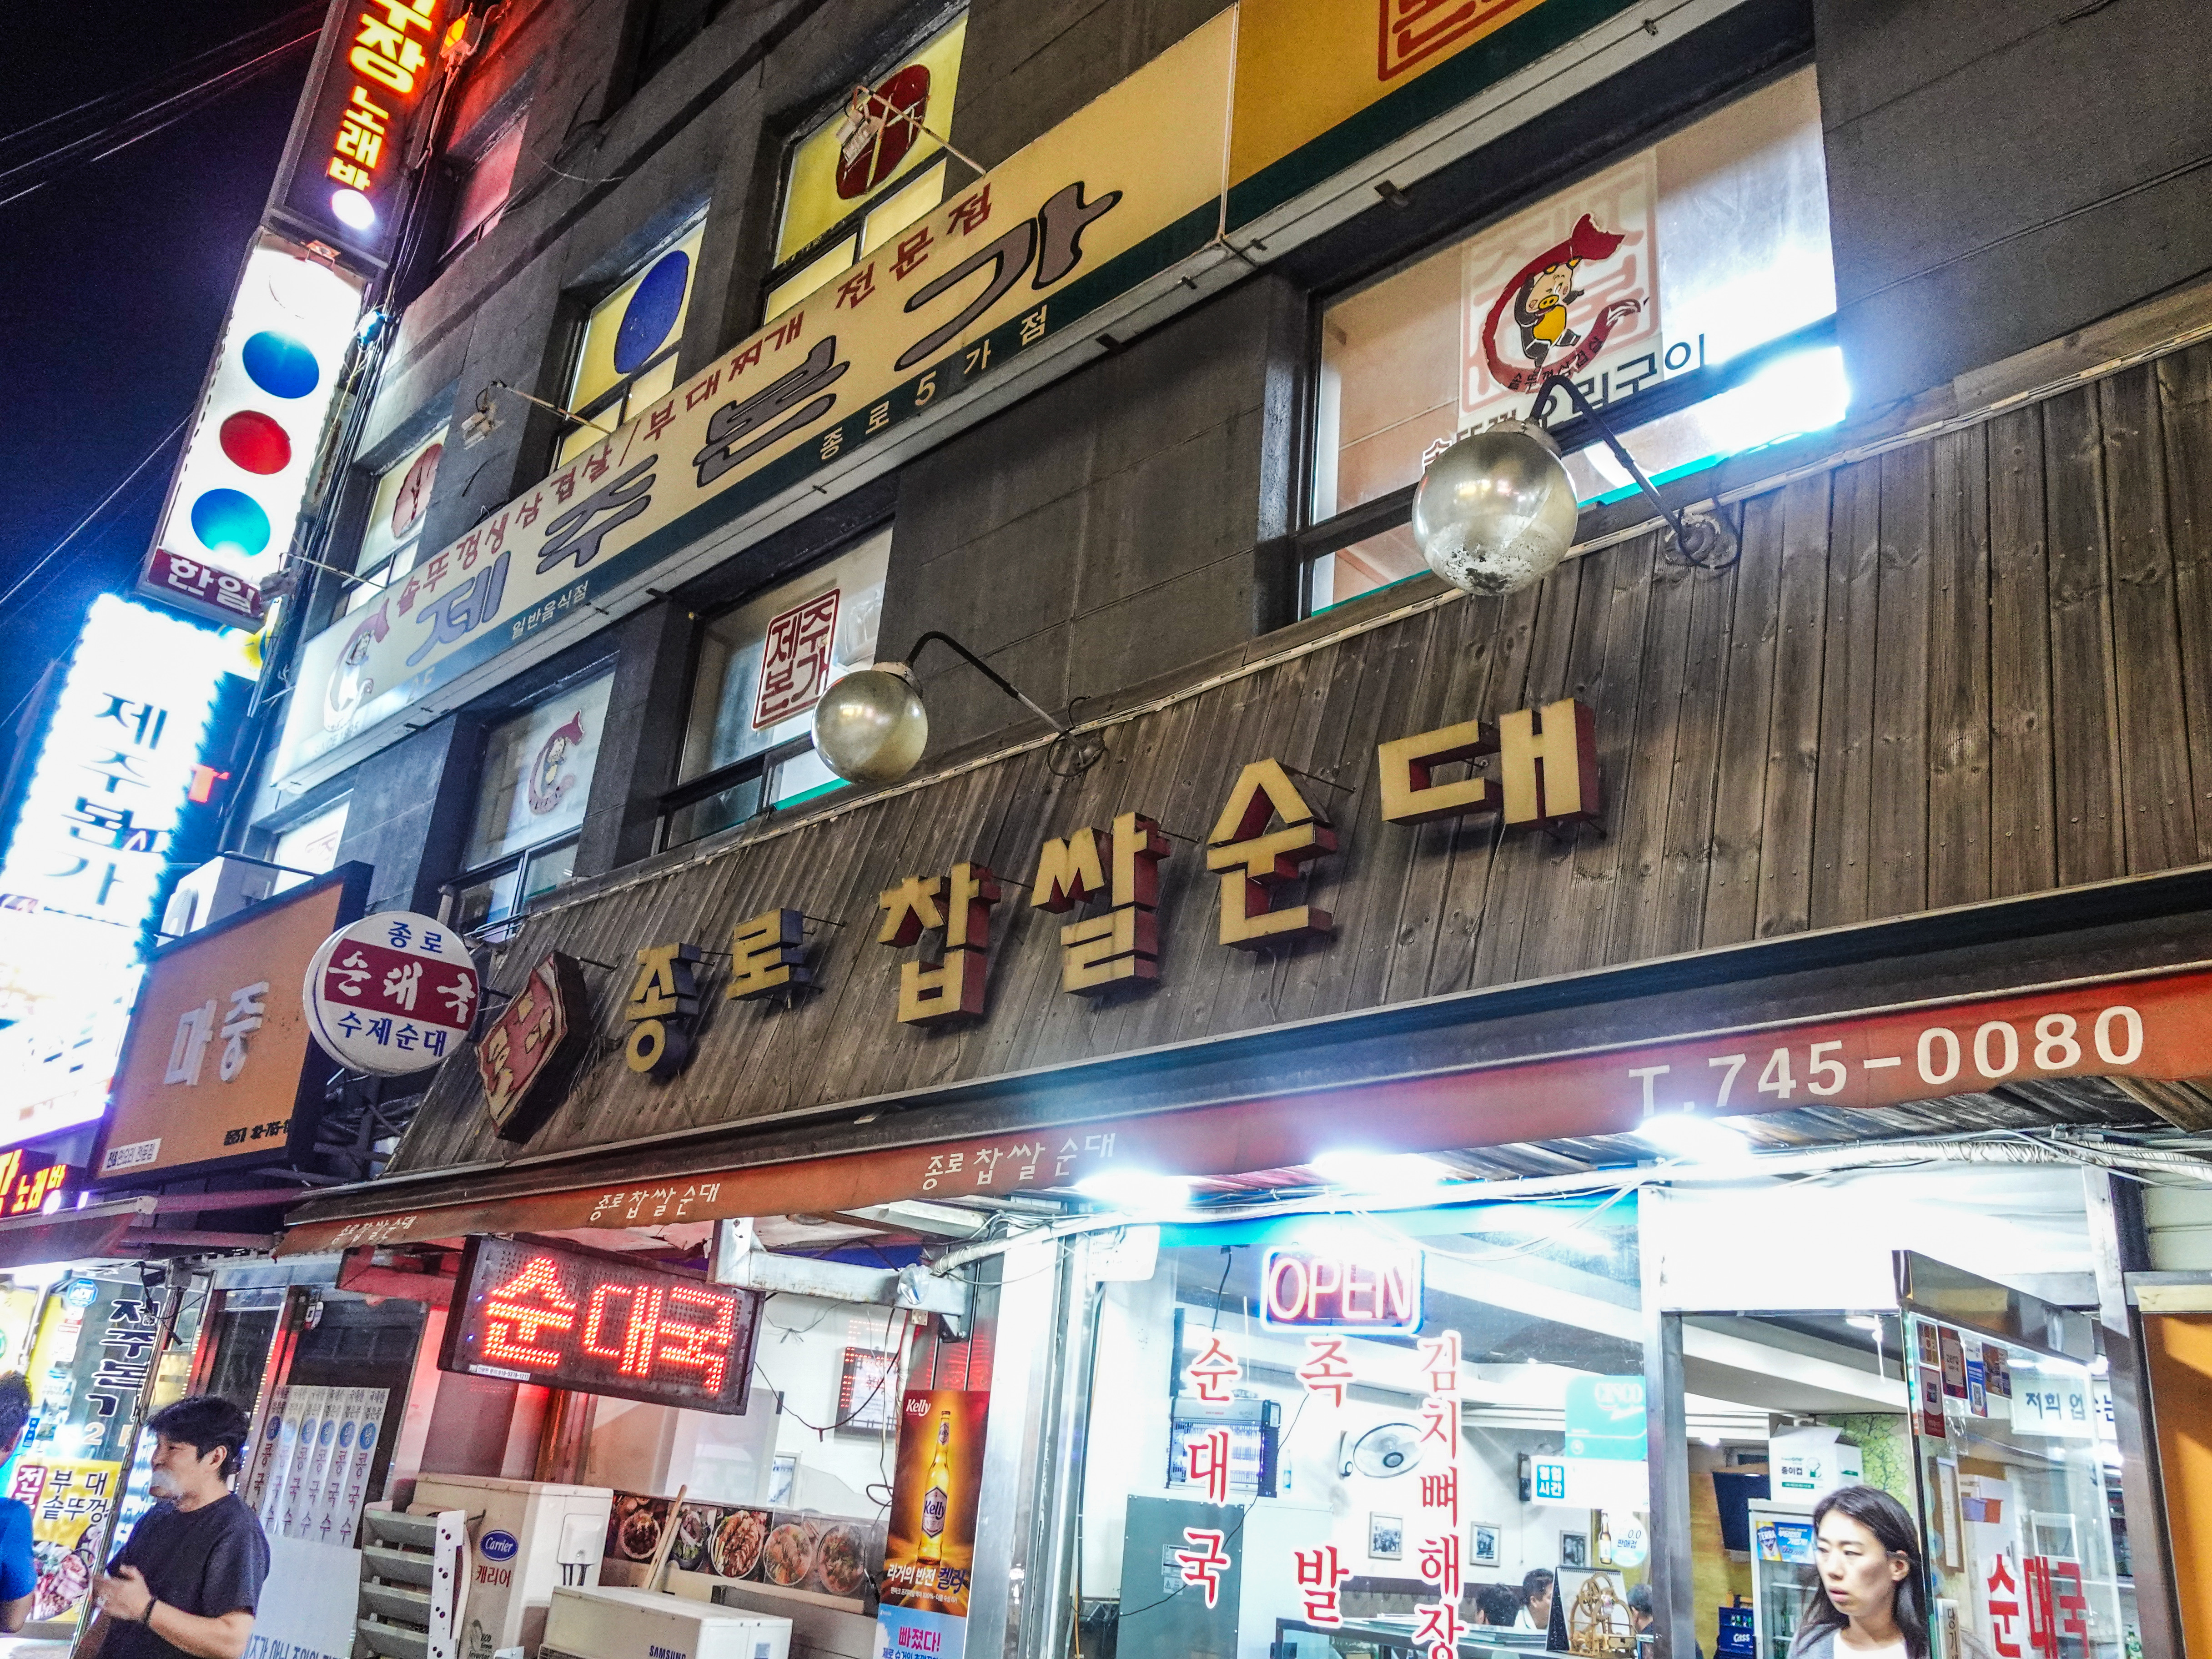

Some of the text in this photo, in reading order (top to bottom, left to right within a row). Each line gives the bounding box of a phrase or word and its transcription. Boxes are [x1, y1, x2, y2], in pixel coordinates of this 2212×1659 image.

[328, 85, 390, 230] 노래방
[835, 182, 992, 309] 전문점
[405, 181, 1123, 667] 제주본가
[168, 558, 255, 614] 한일
[512, 580, 588, 640] 일반음식점
[43, 691, 168, 906] 제주본가
[388, 921, 442, 954] 종로
[625, 909, 811, 1073] 종로
[164, 981, 269, 1086] 마중
[337, 1011, 447, 1057] 수제순대
[1267, 1257, 1414, 1320] OPEN
[483, 1257, 736, 1394] 순대국
[905, 1398, 931, 1417] Kelly
[2026, 1393, 2061, 1420] 저희
[1178, 1337, 1239, 1604] 순대국
[1294, 1339, 1354, 1623] 족발
[1539, 1466, 1562, 1481] 영업
[1539, 1481, 1563, 1497] 시간
[924, 1499, 945, 1520] Kelly
[1628, 1529, 1641, 1539] 0.0
[485, 1537, 513, 1553] Carrier
[1617, 1539, 1637, 1549] 판매점
[475, 1565, 512, 1588] 캐리어
[887, 1563, 916, 1584] 라거의
[915, 1567, 937, 1587] 반전
[1987, 1553, 2091, 1659] 순대국
[898, 1626, 941, 1653] 빠졌다!
